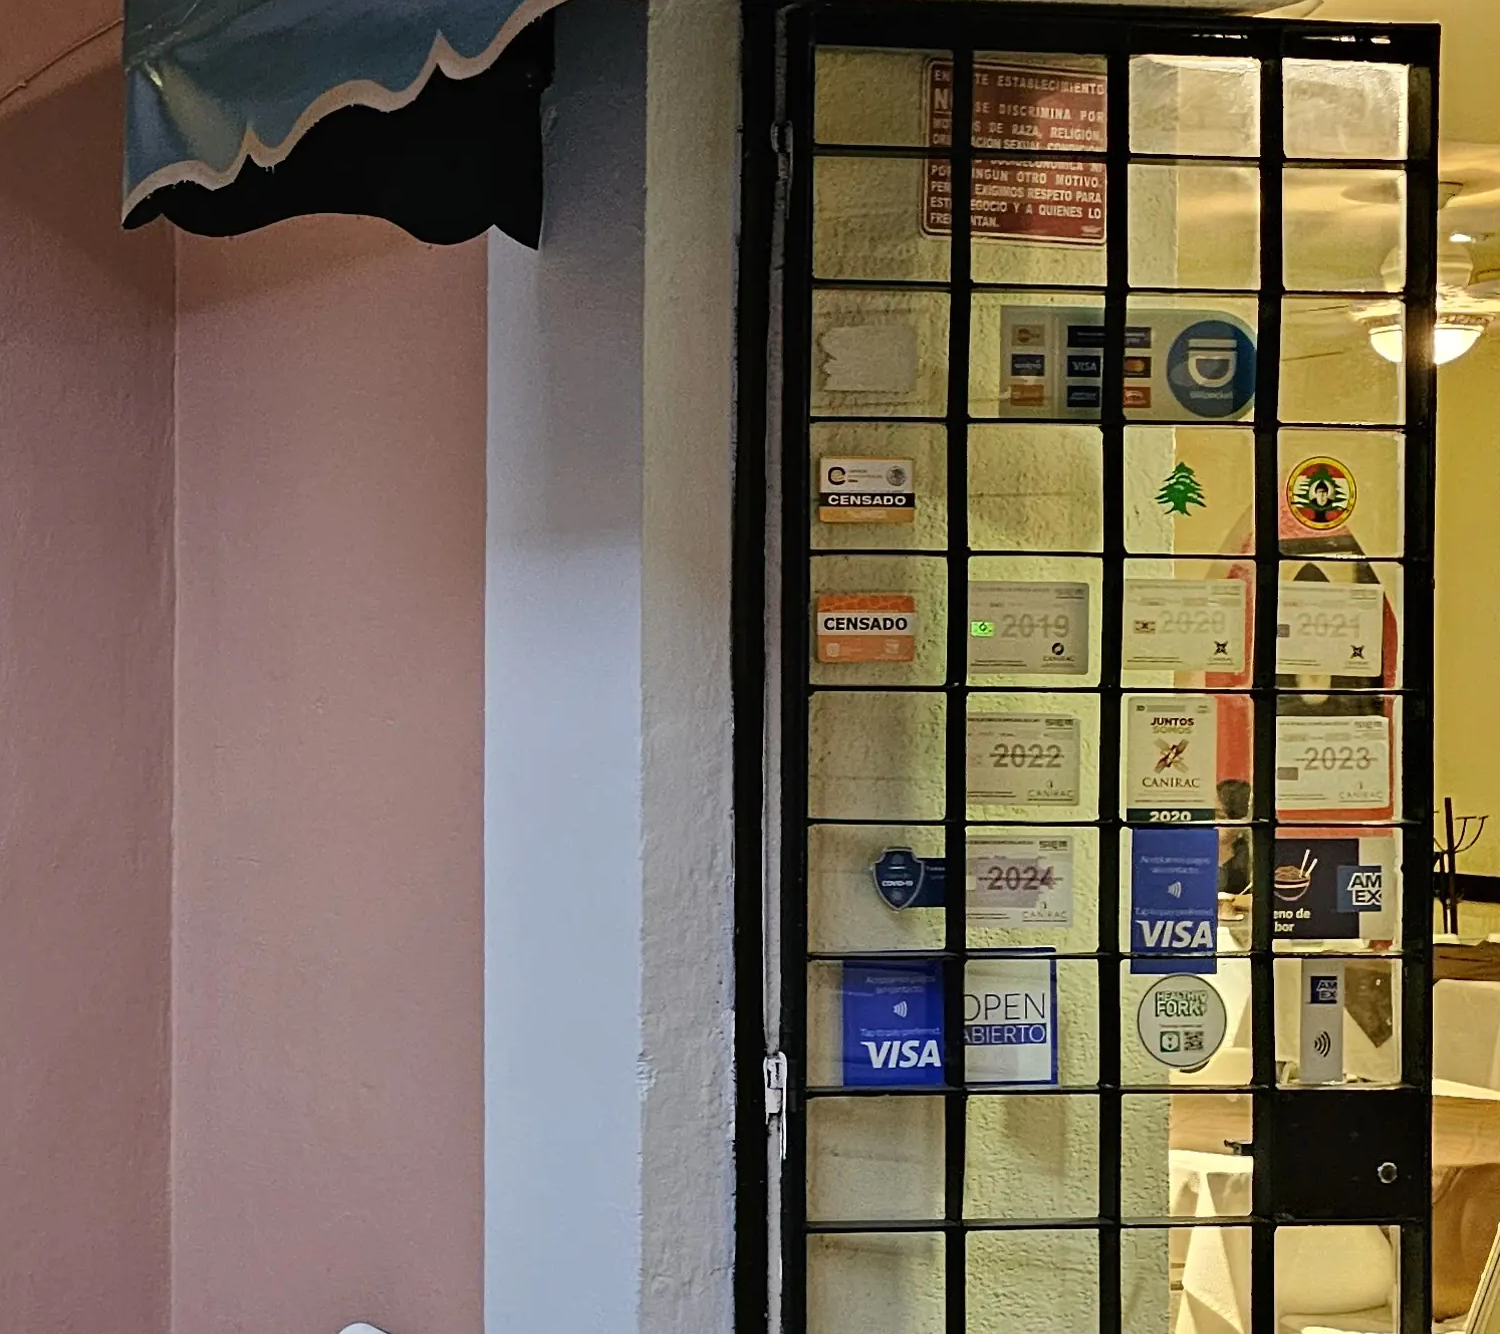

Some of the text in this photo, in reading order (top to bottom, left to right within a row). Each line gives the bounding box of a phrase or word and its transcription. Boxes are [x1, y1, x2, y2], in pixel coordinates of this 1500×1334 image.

[997, 75, 1105, 96] ESTABLECIMIENTO
[975, 101, 990, 114] SE
[999, 103, 1072, 120] DISCRIMINA
[1080, 110, 1105, 124] POR
[988, 122, 1004, 134] DE
[1016, 171, 1047, 184] OTRO
[1055, 174, 1103, 188] MOTIVO.
[975, 184, 1024, 198] EXIGIMOS
[1027, 188, 1072, 202] RESPETO
[1076, 190, 1102, 203] PARA
[971, 199, 1008, 212] EGOCIO
[1013, 202, 1021, 214] Y
[1025, 203, 1033, 214] A
[1038, 204, 1083, 218] QUIENES
[1088, 207, 1101, 219] LO
[1071, 360, 1097, 371] VISA
[828, 495, 906, 505] CENSADO
[824, 617, 908, 631] CENSADO
[1001, 613, 1070, 639] 2019
[1151, 717, 1194, 726] JUNTOS
[993, 743, 1062, 768] 2022
[1304, 747, 1371, 771] 2023
[1142, 777, 1200, 788] CANIRAC
[1150, 810, 1192, 821] 2020
[987, 866, 1057, 890] 2024
[1347, 873, 1382, 890] AM
[1352, 890, 1382, 905] EX
[1296, 908, 1311, 919] de
[1135, 920, 1213, 948] VISA
[860, 1039, 942, 1068] VISA
